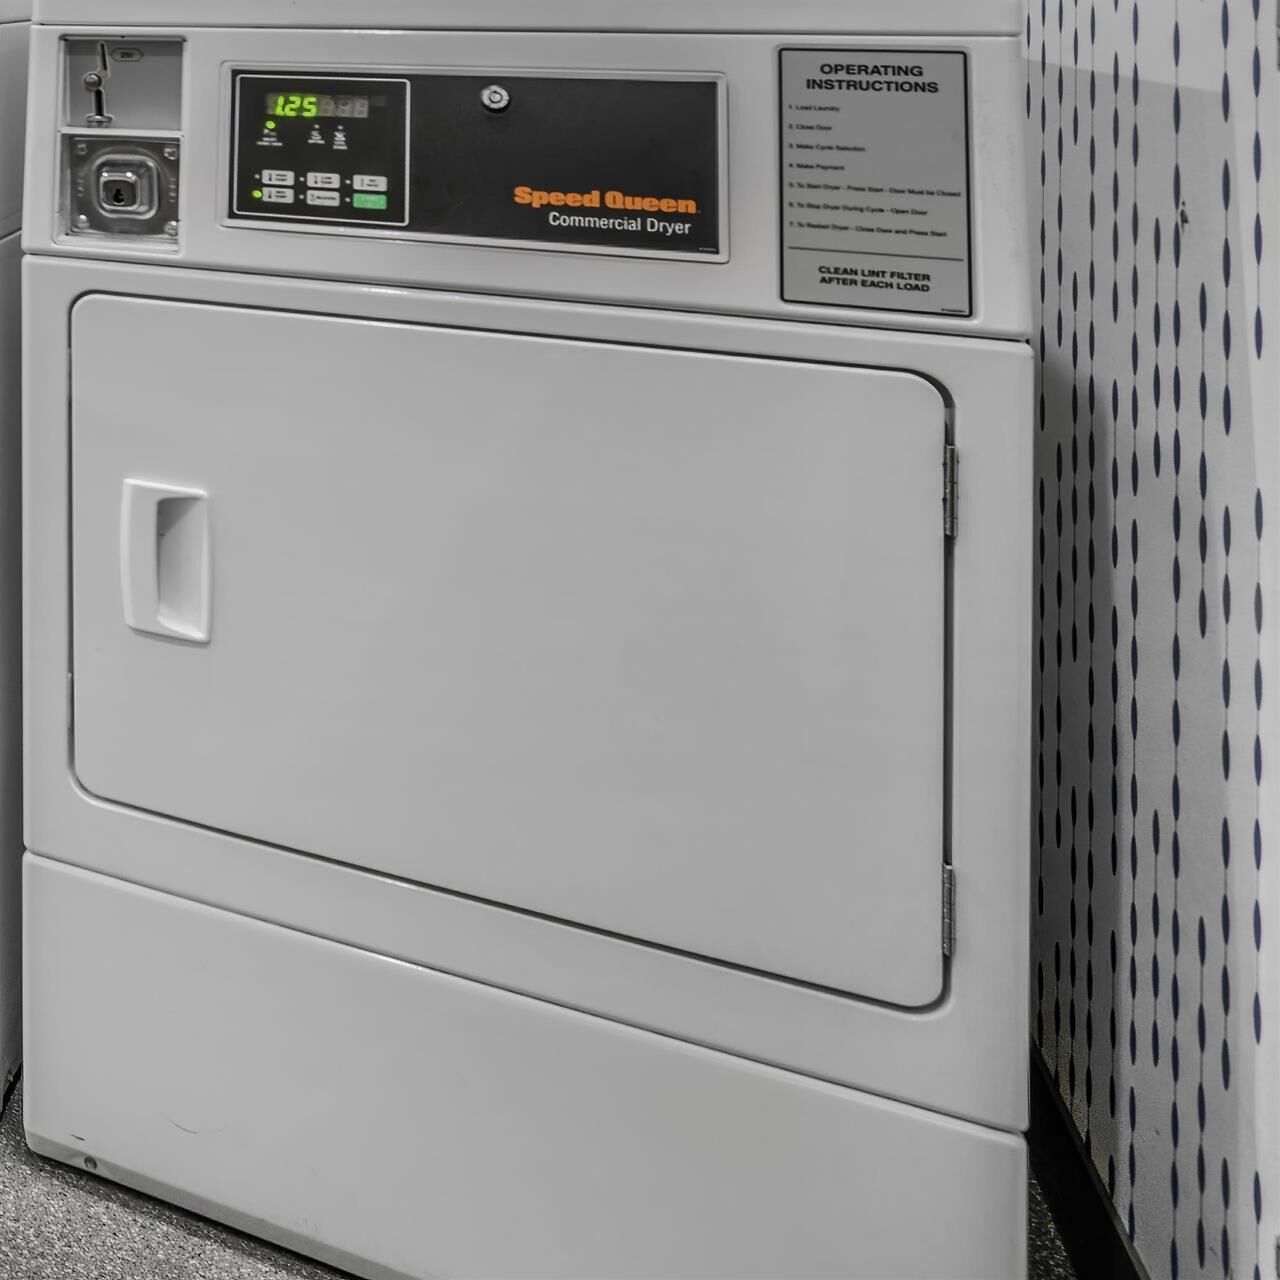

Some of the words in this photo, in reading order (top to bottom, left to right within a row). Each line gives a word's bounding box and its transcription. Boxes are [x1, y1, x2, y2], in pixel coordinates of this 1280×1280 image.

[820, 63, 923, 77] OPERATING
[805, 78, 939, 93] INSTRUCTIONS
[513, 186, 600, 208] Speed
[604, 191, 697, 213] Queen
[548, 211, 641, 231] Commercial
[647, 218, 692, 236] Dryer
[818, 266, 858, 276] CLEAN
[861, 269, 888, 278] LINT
[890, 271, 931, 282] FILTER
[819, 276, 858, 286] AFTER
[861, 279, 893, 289] EACH
[896, 282, 931, 292] LOAD
